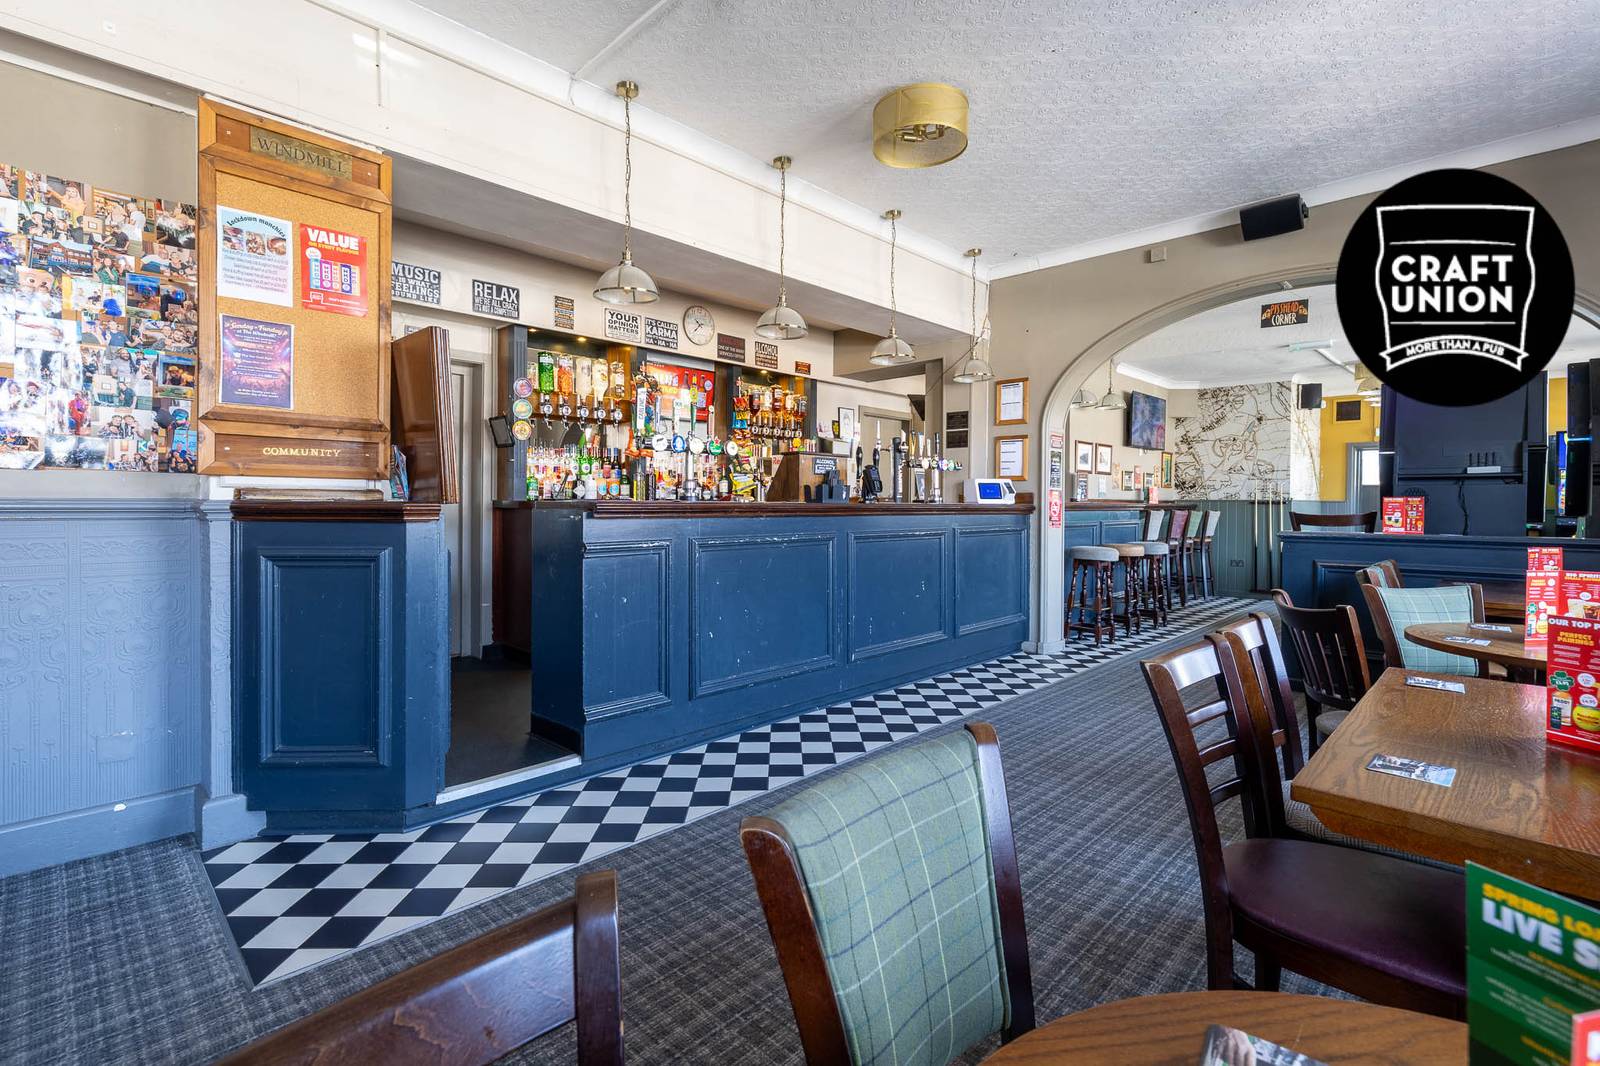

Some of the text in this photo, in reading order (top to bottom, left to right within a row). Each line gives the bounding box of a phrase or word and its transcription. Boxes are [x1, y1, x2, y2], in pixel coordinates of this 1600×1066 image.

[306, 228, 360, 251] VALUE
[392, 262, 439, 284] MUSIC
[474, 281, 518, 304] RELAX
[608, 310, 639, 325] YOUR
[608, 318, 639, 330] OPINION
[1271, 312, 1297, 326] CORNER
[608, 324, 639, 335] MATTERS
[645, 324, 677, 339] KARMA
[657, 320, 678, 331] CALLED
[262, 447, 341, 457] COMMUNITY
[1549, 618, 1569, 627] OUR
[1571, 620, 1592, 629] TOP
[1482, 882, 1560, 925] SPRING
[1482, 897, 1564, 956] LIVE
